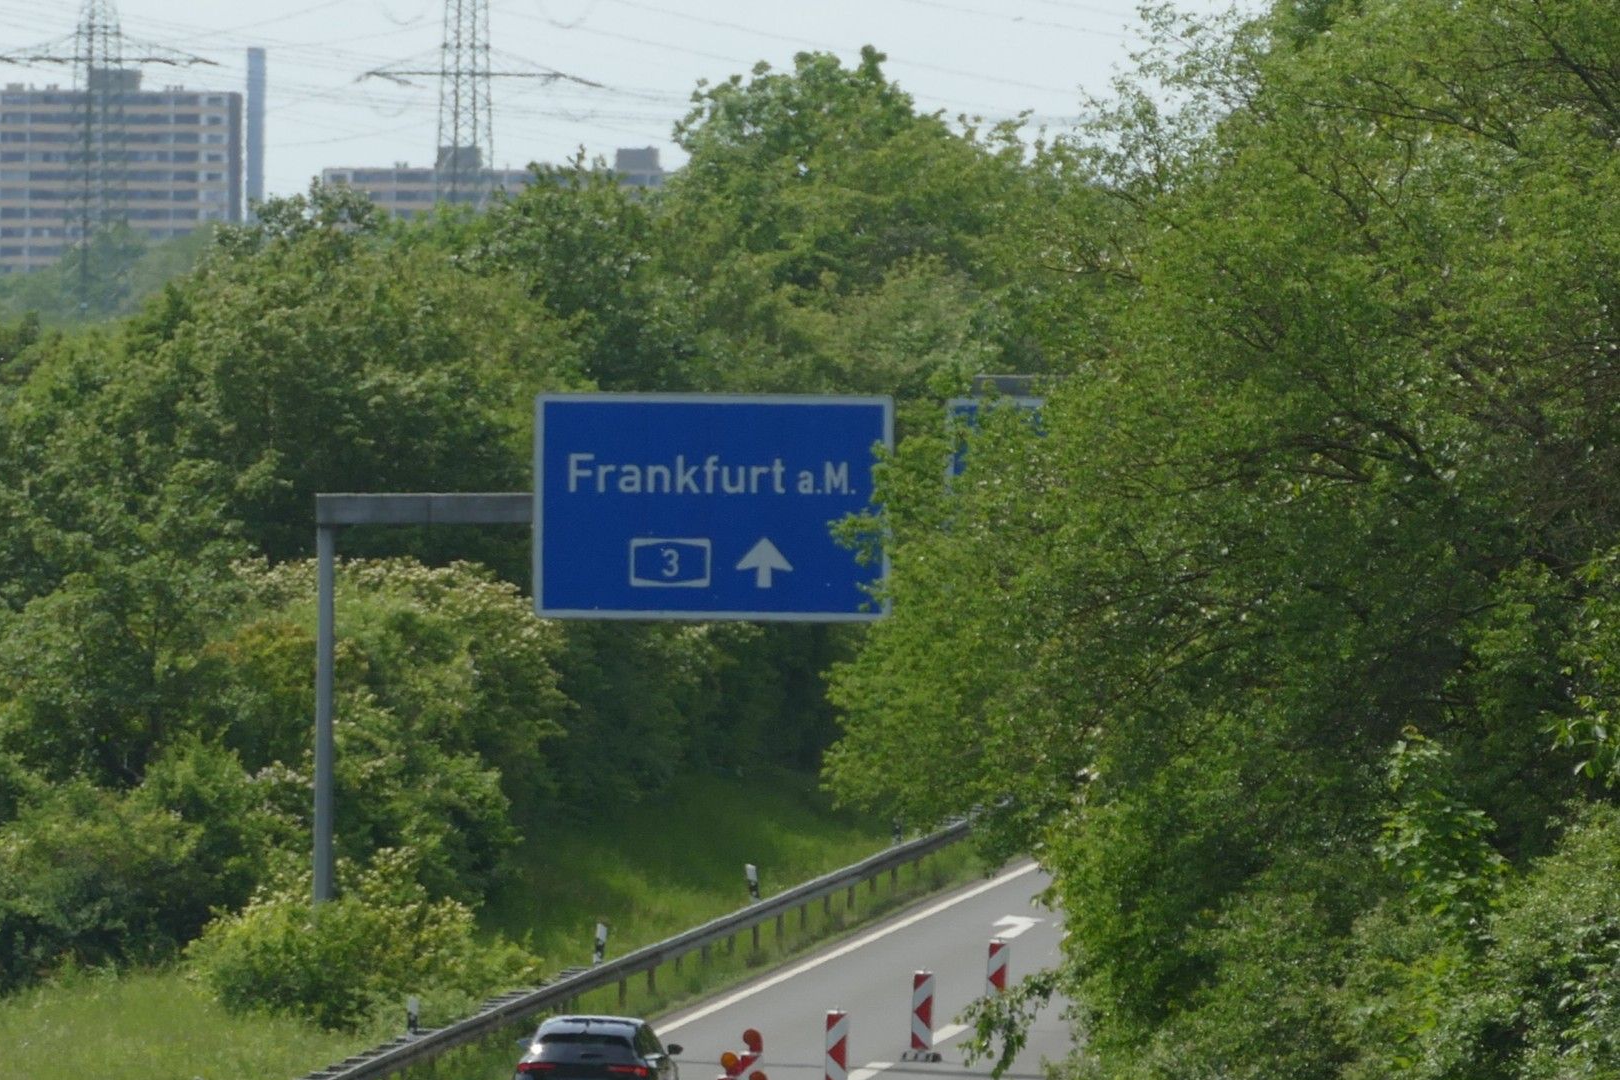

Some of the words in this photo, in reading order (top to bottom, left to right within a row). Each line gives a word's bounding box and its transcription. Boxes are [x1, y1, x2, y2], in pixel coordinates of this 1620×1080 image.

[568, 453, 786, 494] Frankfurt
[797, 461, 857, 494] a.M.
[661, 548, 680, 577] 3
